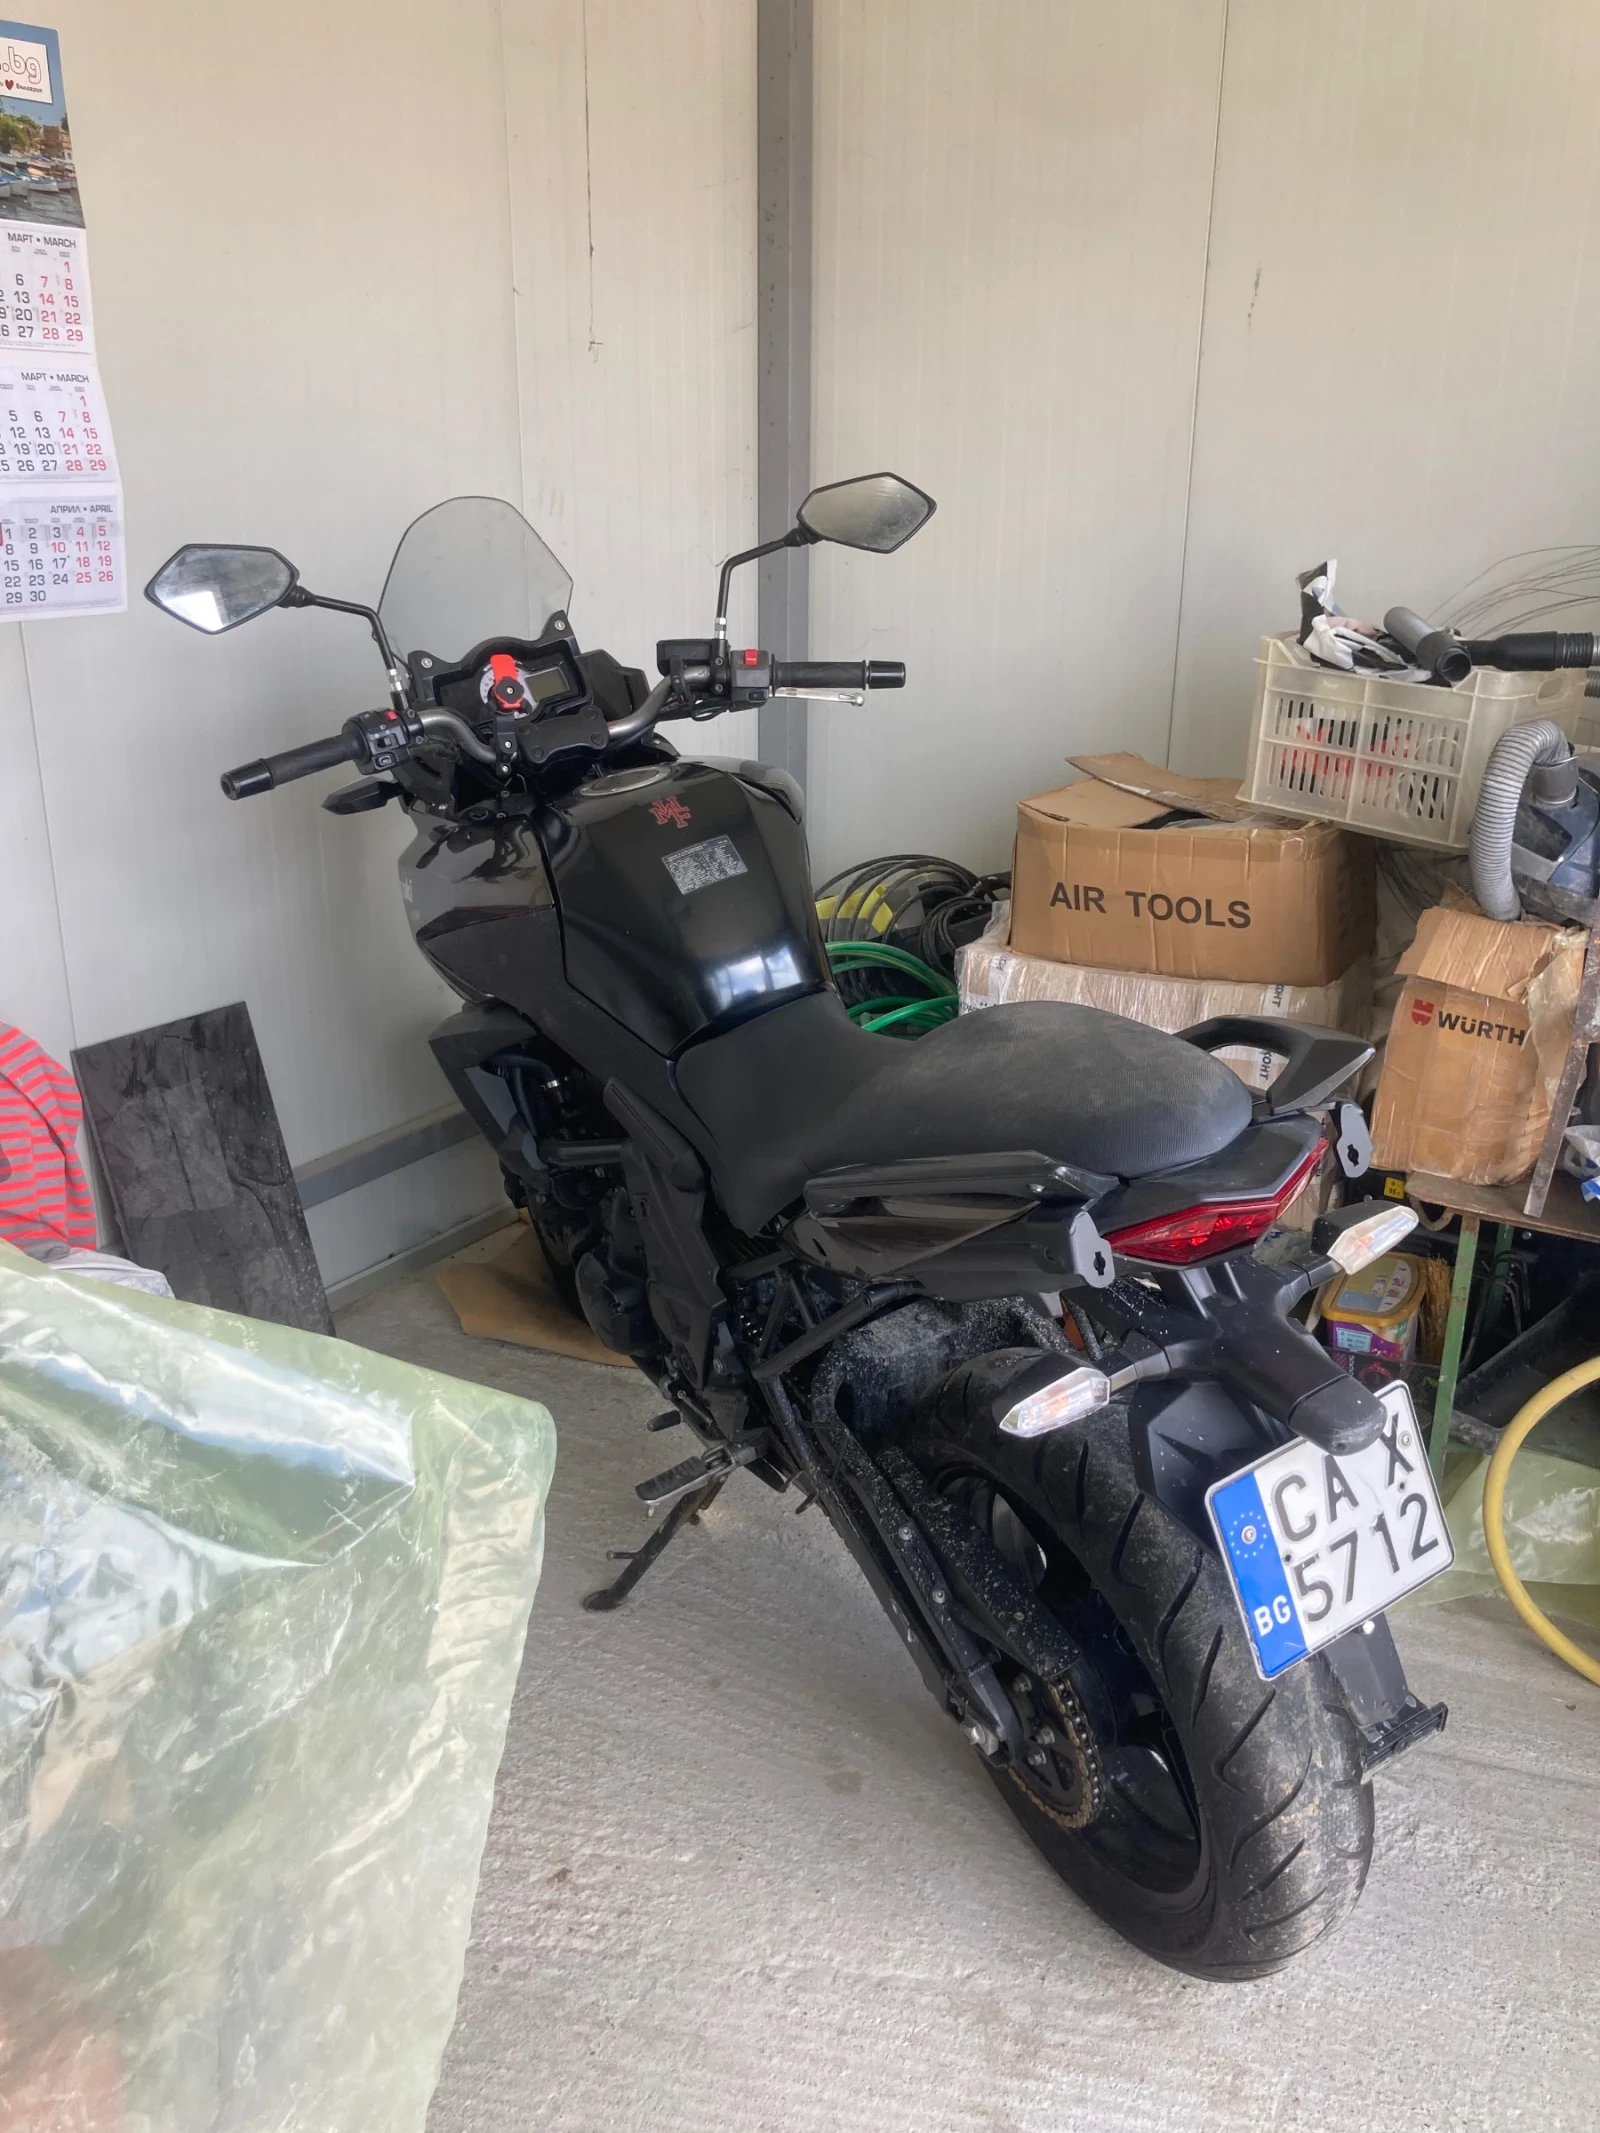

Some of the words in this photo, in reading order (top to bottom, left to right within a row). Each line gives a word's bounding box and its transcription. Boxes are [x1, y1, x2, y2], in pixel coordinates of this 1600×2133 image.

[0, 46, 42, 84] .bg
[63, 261, 70, 274] 1
[15, 273, 25, 286] 6
[40, 275, 48, 288] 7
[64, 278, 73, 290] 8
[13, 290, 30, 304] 13
[38, 293, 55, 306] 14
[63, 295, 79, 308] 15
[15, 308, 33, 321] 20
[41, 310, 57, 323] 21
[65, 312, 81, 325] 22
[17, 326, 34, 338] 27
[42, 327, 60, 340] 28
[66, 329, 84, 342] 29
[80, 395, 87, 407] 1
[8, 409, 18, 422] 5
[33, 410, 43, 423] 6
[58, 410, 66, 423] 7
[82, 411, 91, 423] 8
[9, 426, 27, 439] 12
[34, 426, 51, 439] 13
[59, 427, 75, 439] 14
[82, 428, 98, 439] 15
[14, 443, 30, 455] 19
[37, 443, 55, 455] 20
[62, 443, 79, 455] 21
[85, 443, 103, 455] 22
[16, 459, 35, 472] 26
[41, 459, 58, 472] 27
[65, 459, 83, 471] 28
[89, 459, 107, 471] 29
[5, 528, 12, 540] 1
[28, 527, 37, 539] 2
[53, 526, 61, 539] 3
[76, 526, 85, 538] 4
[98, 525, 107, 536] 5
[5, 543, 14, 555] 8
[30, 542, 39, 554] 9
[51, 542, 66, 553] 10
[75, 541, 89, 553] 11
[96, 541, 110, 551] 12
[4, 559, 20, 572] 15
[28, 558, 43, 570] 16
[52, 558, 67, 569] 17
[76, 556, 91, 568] 18
[98, 555, 112, 567] 19
[4, 576, 21, 588] 22
[28, 574, 46, 586] 23
[52, 573, 69, 585] 24
[76, 572, 92, 584] 25
[98, 571, 114, 582] 26
[6, 592, 23, 604] 29
[30, 590, 46, 602] 30
[1050, 882, 1106, 914] AIR
[1125, 890, 1251, 928] TOOLS
[1272, 1453, 1359, 1542] CA
[1380, 1412, 1415, 1488] X
[1291, 1493, 1439, 1622] 5712
[1254, 1594, 1292, 1637] BG
